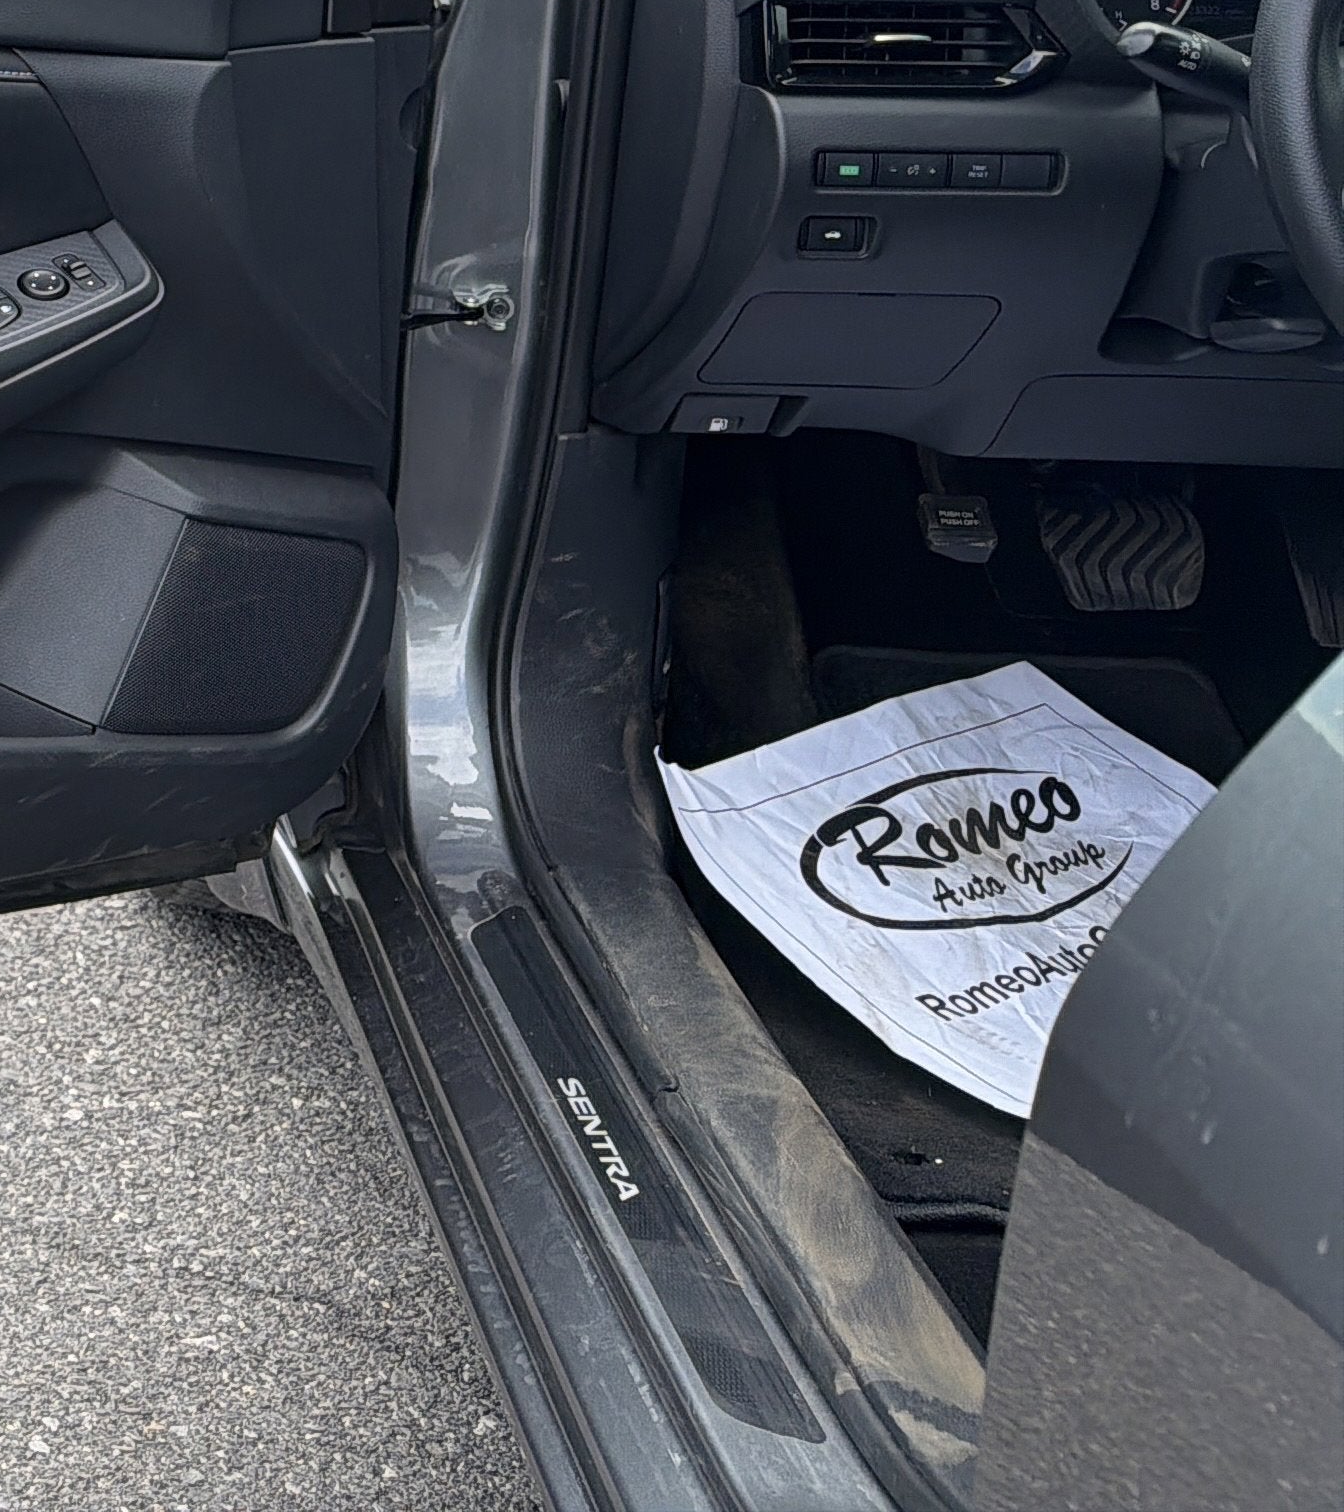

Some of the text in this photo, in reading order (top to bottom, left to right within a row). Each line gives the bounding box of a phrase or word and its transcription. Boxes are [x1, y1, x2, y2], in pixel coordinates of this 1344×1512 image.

[938, 510, 975, 519] PUSH ON
[940, 518, 980, 527] PUSH OFF
[816, 776, 1082, 887] Romeo
[933, 839, 1106, 913] Auto Group
[556, 1077, 641, 1202] SENTRA
